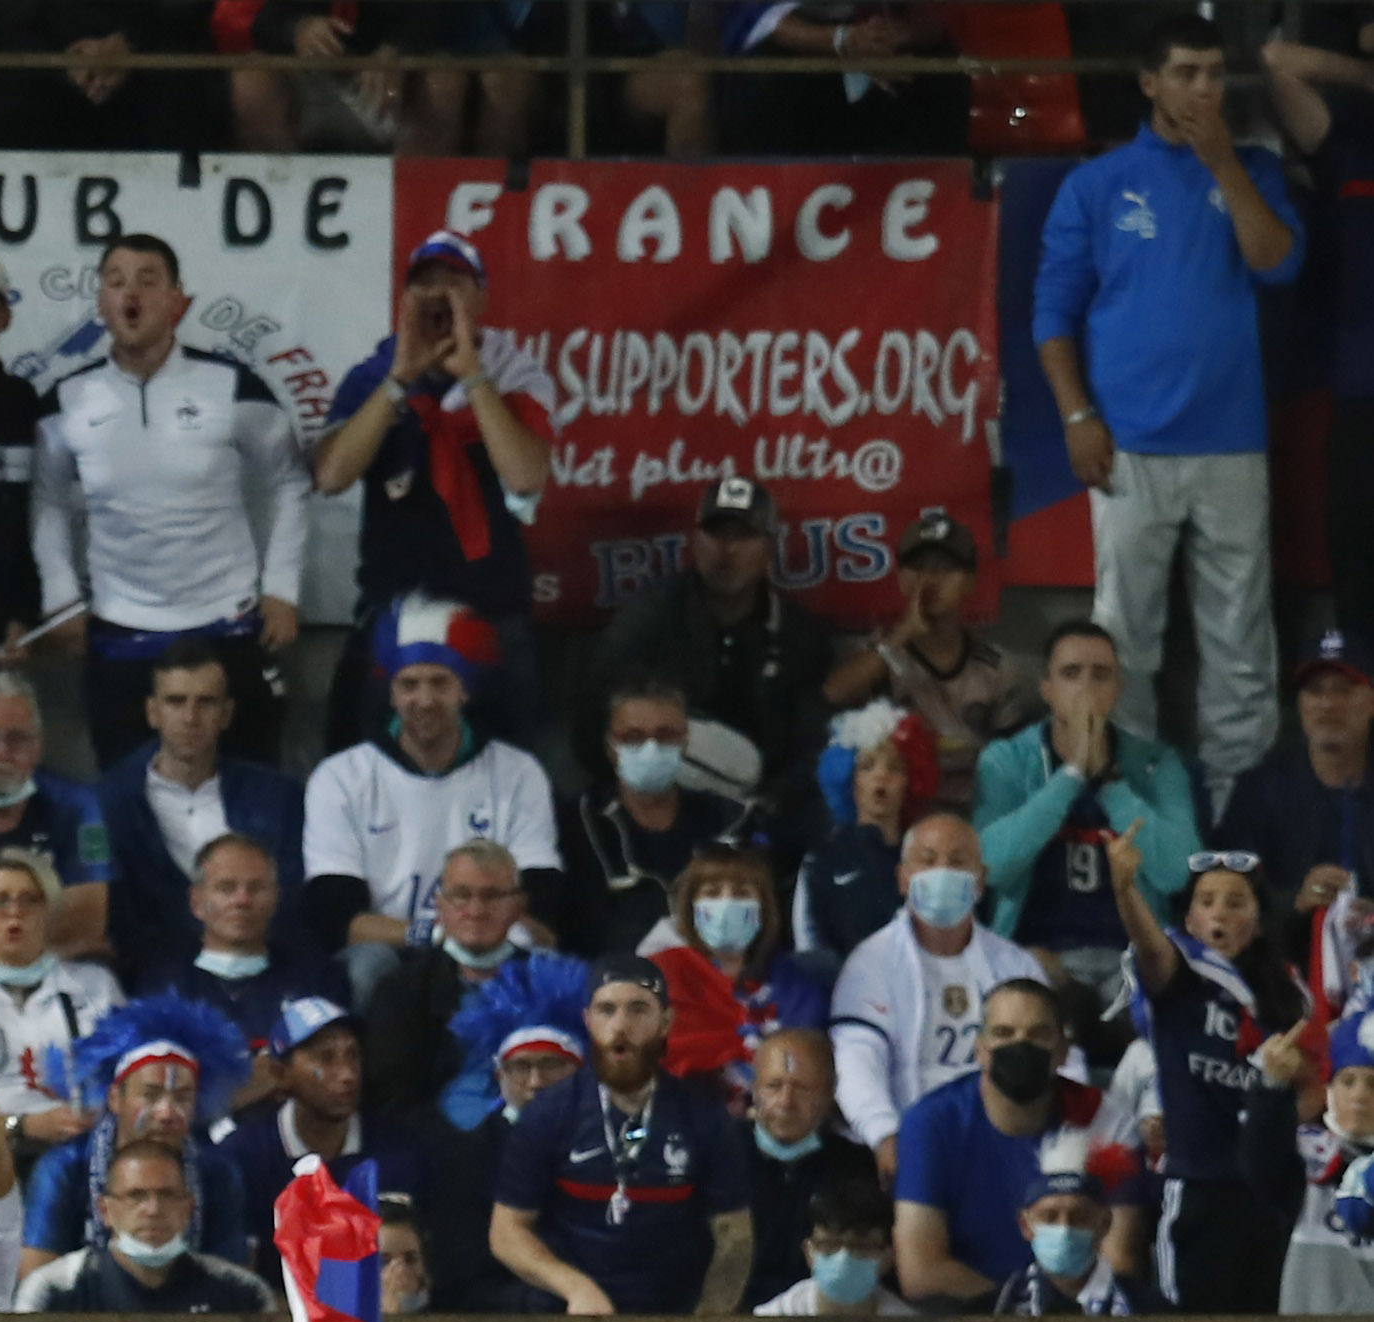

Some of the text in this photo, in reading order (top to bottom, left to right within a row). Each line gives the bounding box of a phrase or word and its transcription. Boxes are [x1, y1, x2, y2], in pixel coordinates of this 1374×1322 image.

[225, 177, 349, 249] DE
[446, 178, 941, 265] FRANCE
[510, 326, 979, 445] SUPPORTERS.ORG
